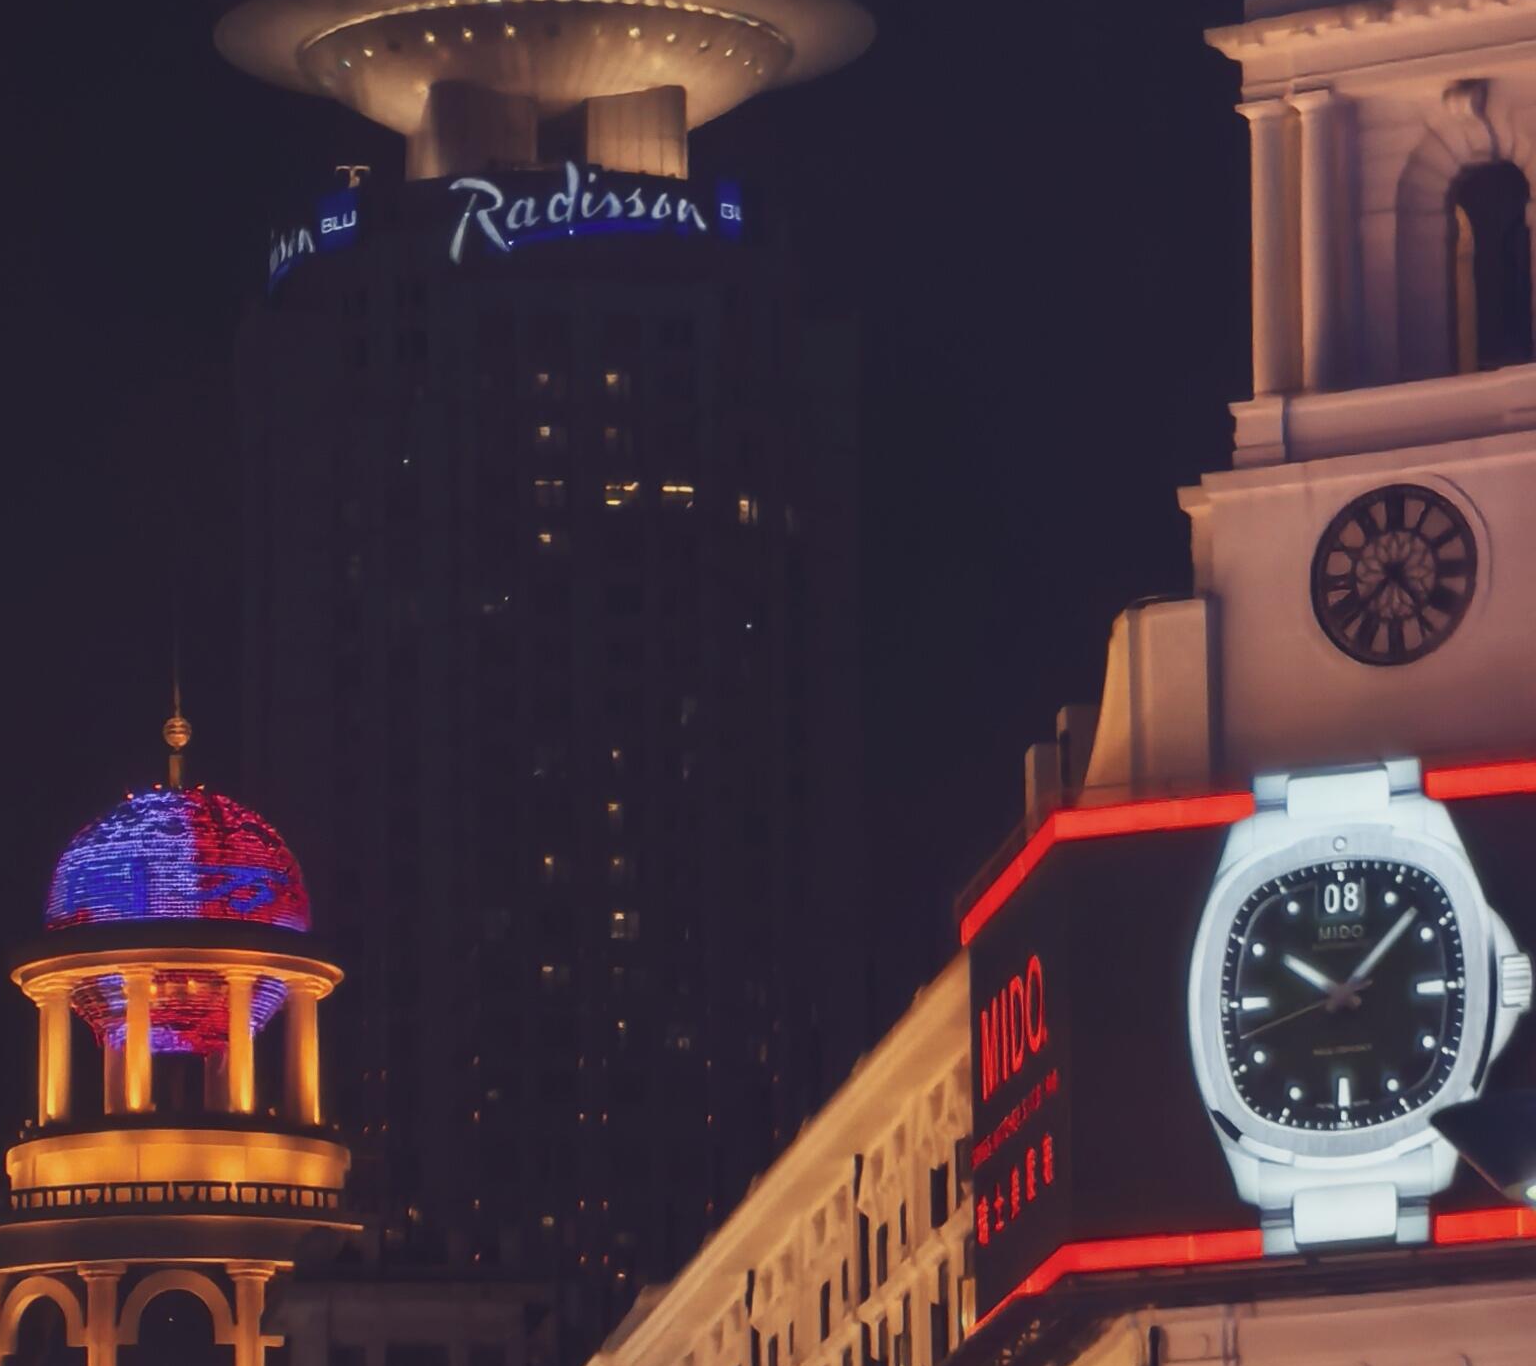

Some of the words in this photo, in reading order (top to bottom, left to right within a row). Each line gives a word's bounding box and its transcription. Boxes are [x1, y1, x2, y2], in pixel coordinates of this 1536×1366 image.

[321, 210, 357, 234] BLU
[449, 160, 707, 265] Radisson
[1324, 881, 1359, 915] 08
[1318, 923, 1365, 941] MIDO
[980, 954, 1044, 1102] MIDO
